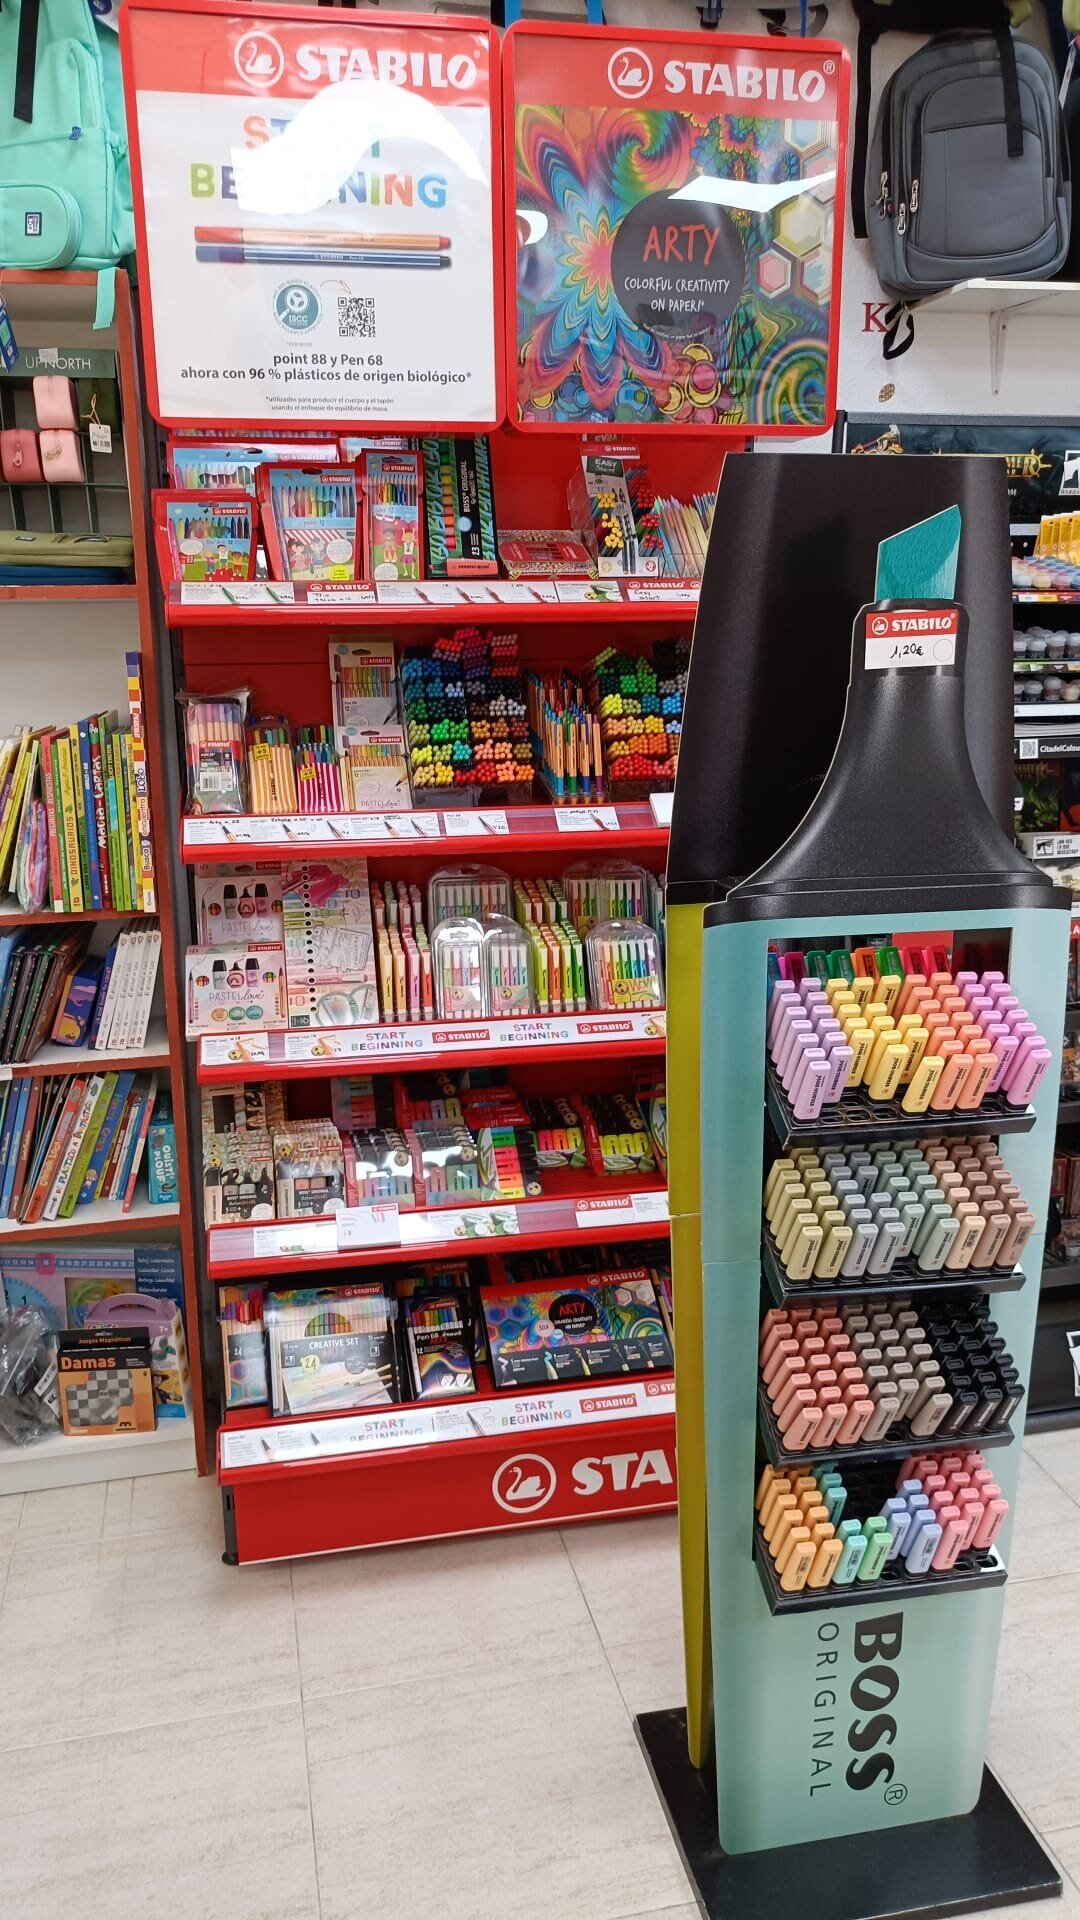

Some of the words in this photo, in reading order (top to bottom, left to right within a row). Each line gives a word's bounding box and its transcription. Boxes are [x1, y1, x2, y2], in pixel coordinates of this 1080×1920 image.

[642, 224, 720, 267] ARTY
[624, 276, 673, 292] COLORFUL
[676, 278, 730, 294] CREATIVITY
[651, 298, 666, 312] ON
[273, 353, 308, 366] point
[311, 354, 327, 365] 88
[330, 357, 337, 367] y
[340, 354, 364, 366] Pen
[367, 355, 383, 366] 68
[180, 367, 219, 379] ahora
[222, 369, 246, 379] con
[249, 368, 266, 380] 96
[268, 369, 281, 380] %
[284, 368, 341, 382] plásticos
[344, 368, 359, 381] de
[362, 370, 404, 385] origen
[66, 816, 78, 875] DINOSAURIOS
[513, 1023, 552, 1031] START
[593, 1022, 629, 1031] STABILO
[366, 1032, 406, 1041] START
[447, 1032, 487, 1041] STABILO
[500, 1031, 569, 1042] BEGINNING
[351, 1039, 423, 1051] BEGINNING
[602, 1271, 646, 1283] STABILO
[559, 1303, 586, 1316] ARTY
[309, 1339, 345, 1350] CREATIVE
[347, 1337, 359, 1346] SET
[61, 1356, 116, 1370] Damas
[515, 1400, 554, 1411] START
[594, 1397, 635, 1409] STABILO
[364, 1418, 406, 1431] START
[502, 1410, 572, 1426] BEGINNING
[810, 1622, 840, 1798] ORIGINAL
